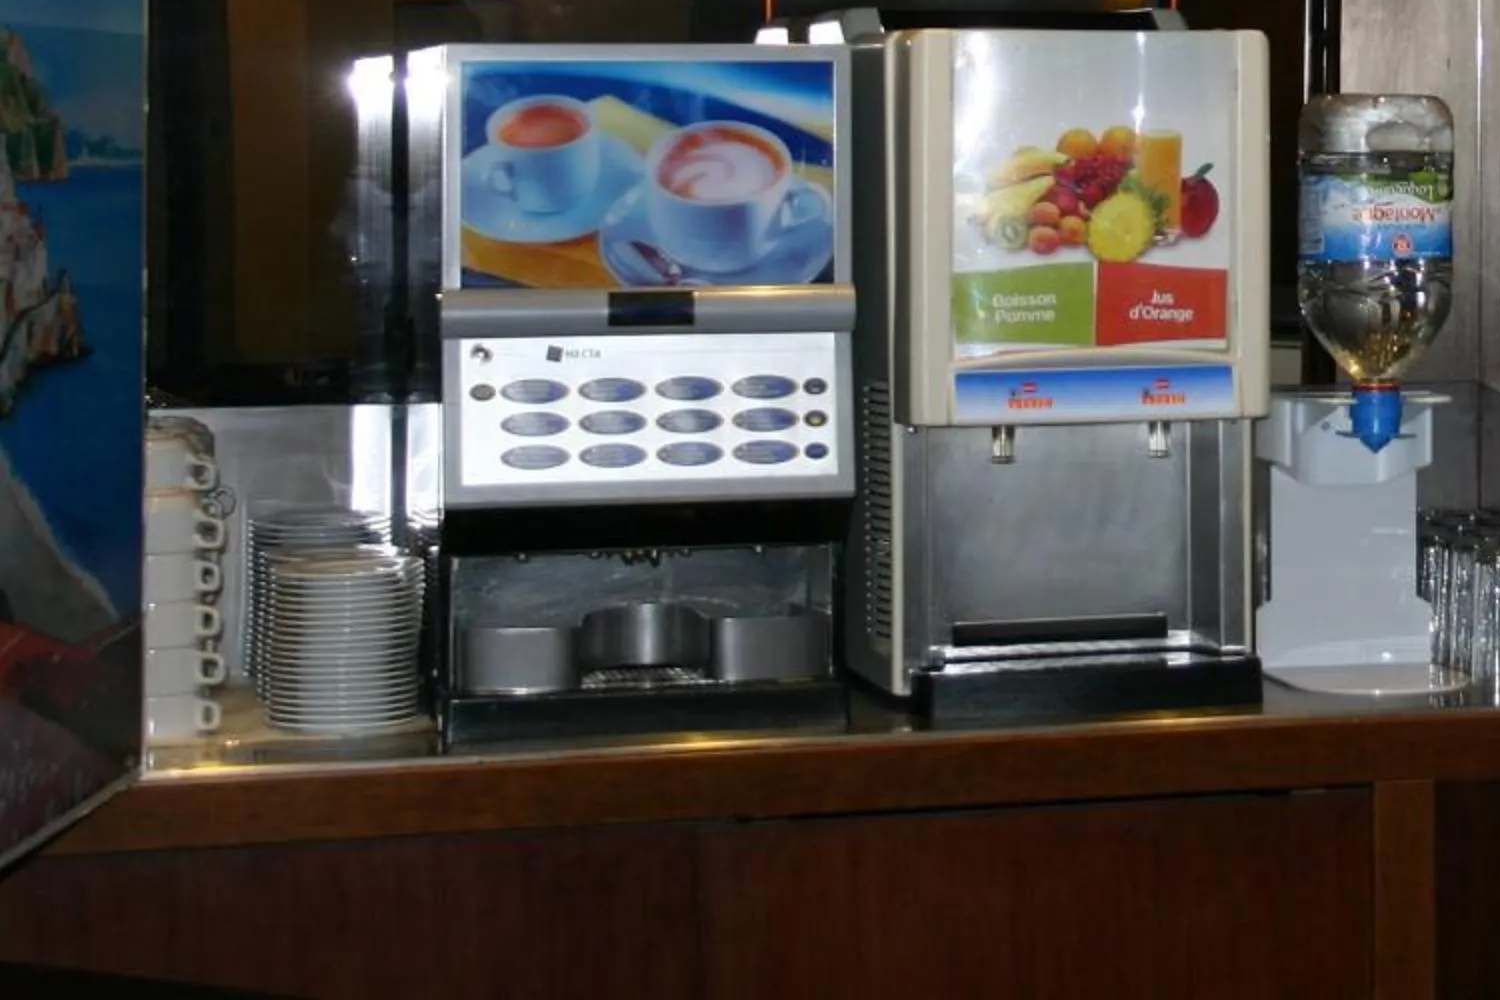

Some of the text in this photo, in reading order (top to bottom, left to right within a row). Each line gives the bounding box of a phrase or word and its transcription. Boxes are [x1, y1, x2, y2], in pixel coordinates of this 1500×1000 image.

[992, 293, 1056, 309] Boisson
[1151, 289, 1174, 304] Jus
[994, 308, 1056, 324] Pomme
[1129, 304, 1195, 321] d'Orange
